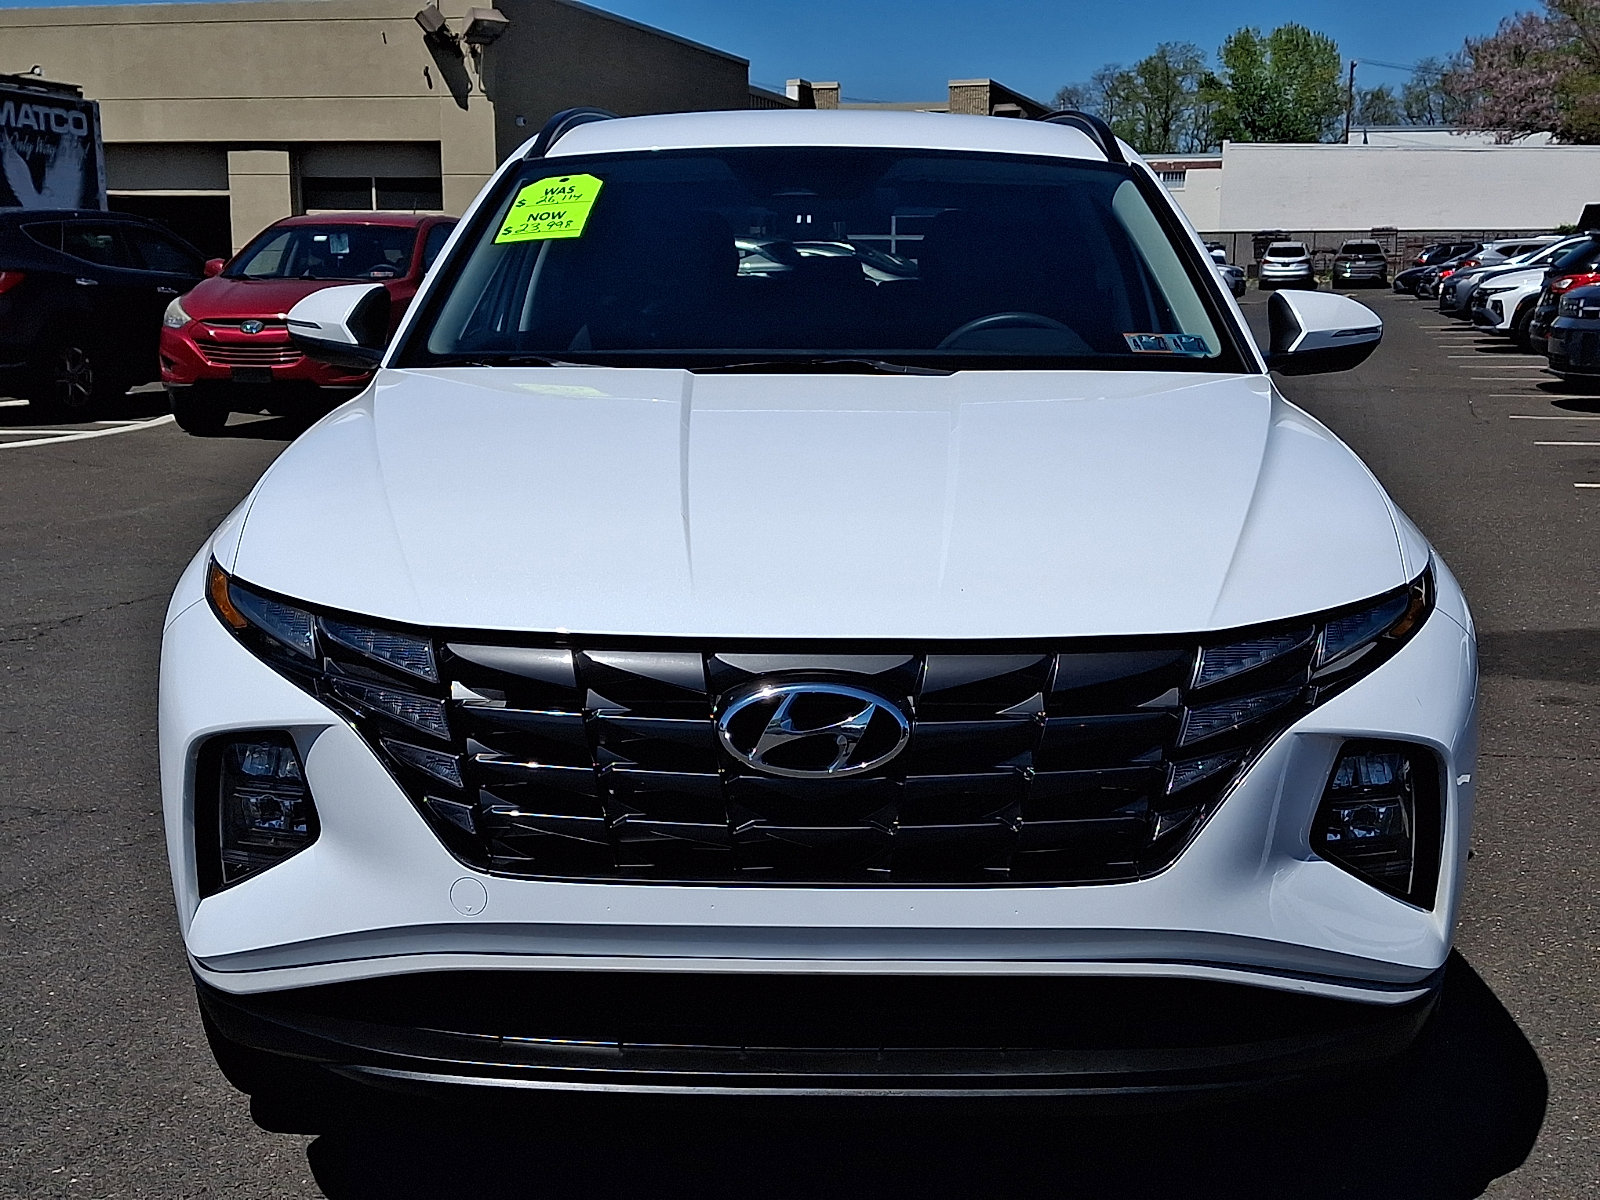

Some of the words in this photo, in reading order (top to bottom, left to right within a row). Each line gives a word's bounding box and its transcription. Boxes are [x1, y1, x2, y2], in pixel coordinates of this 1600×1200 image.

[544, 186, 576, 196] WAS
[515, 198, 527, 208] $
[527, 211, 567, 222] NOW
[501, 226, 513, 235] $
